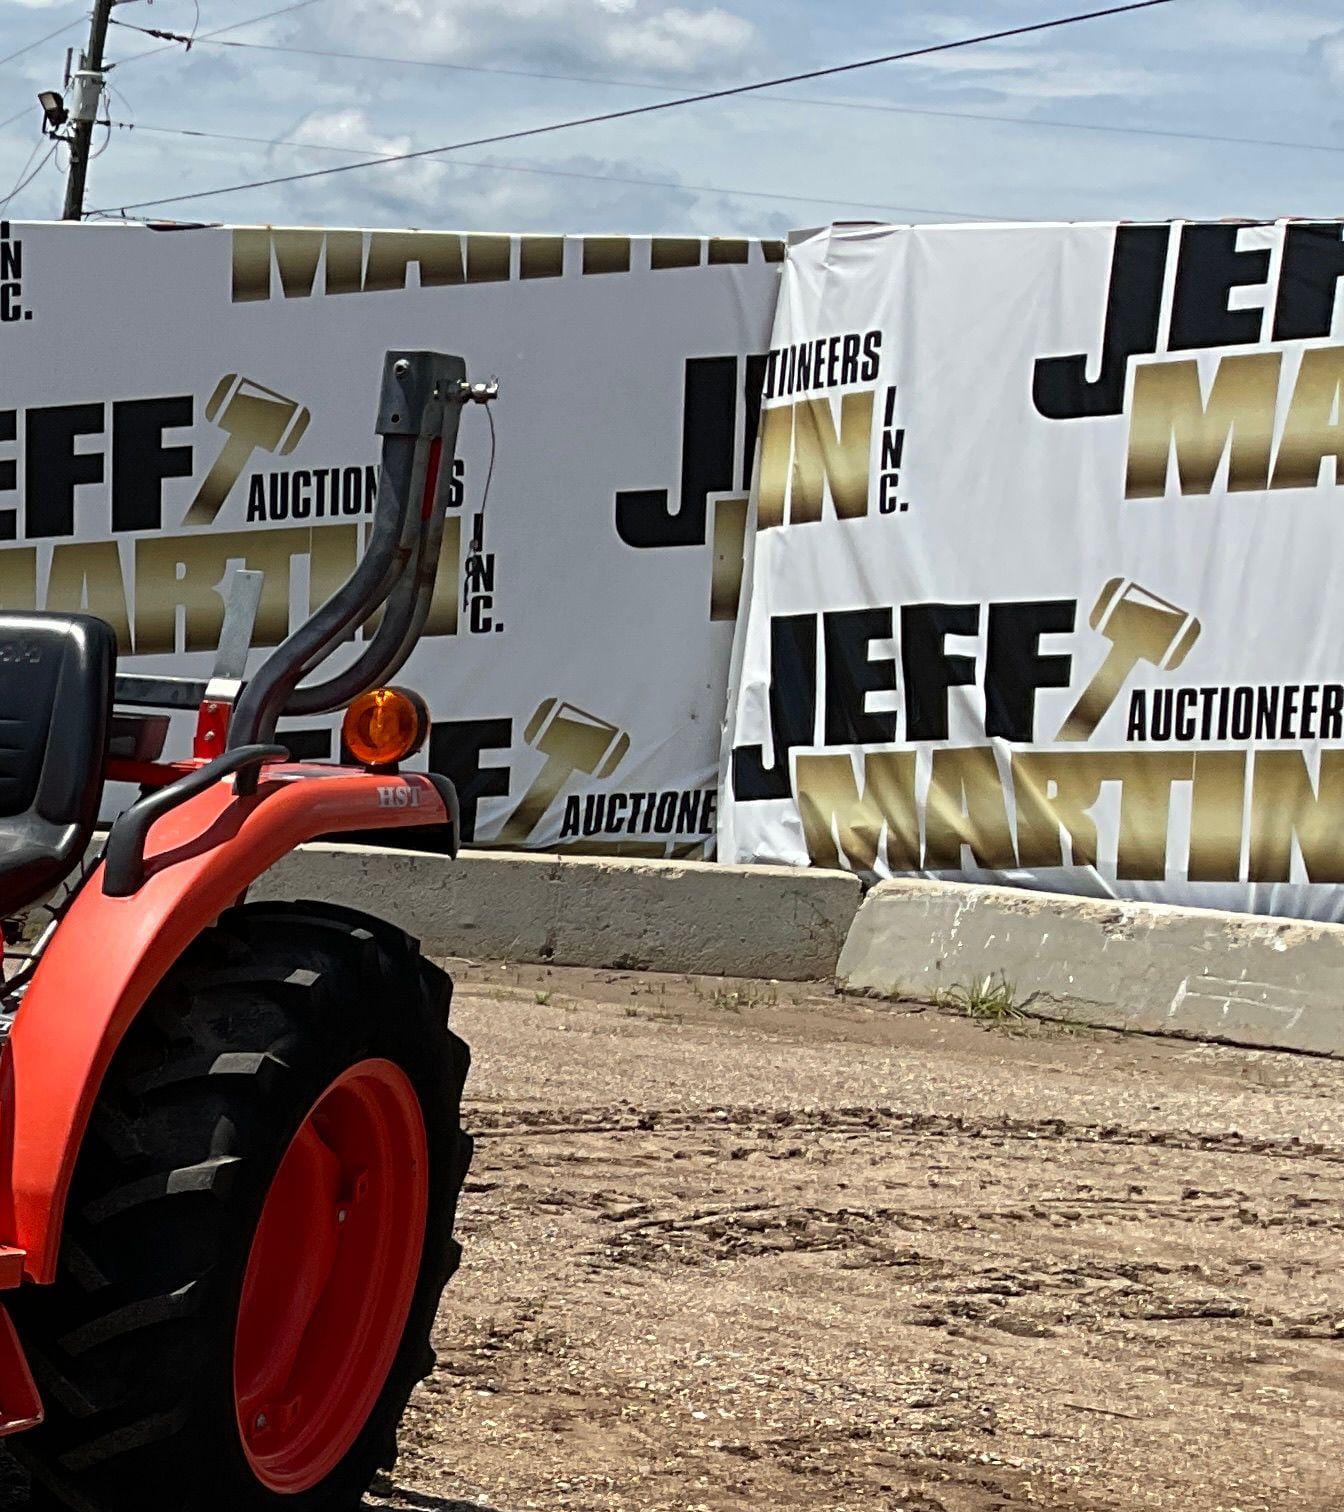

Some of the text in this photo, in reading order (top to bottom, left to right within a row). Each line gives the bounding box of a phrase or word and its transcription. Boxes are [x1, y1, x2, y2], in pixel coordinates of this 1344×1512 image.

[1032, 223, 1344, 420] JEF
[879, 385, 909, 515] INC.
[469, 512, 505, 634] INC.
[732, 599, 1078, 801] JEFF
[1126, 684, 1344, 743] AUCTIONEER
[376, 786, 423, 808] HST
[559, 789, 718, 839] AUCTIONE
[793, 746, 1344, 884] MARTIN
